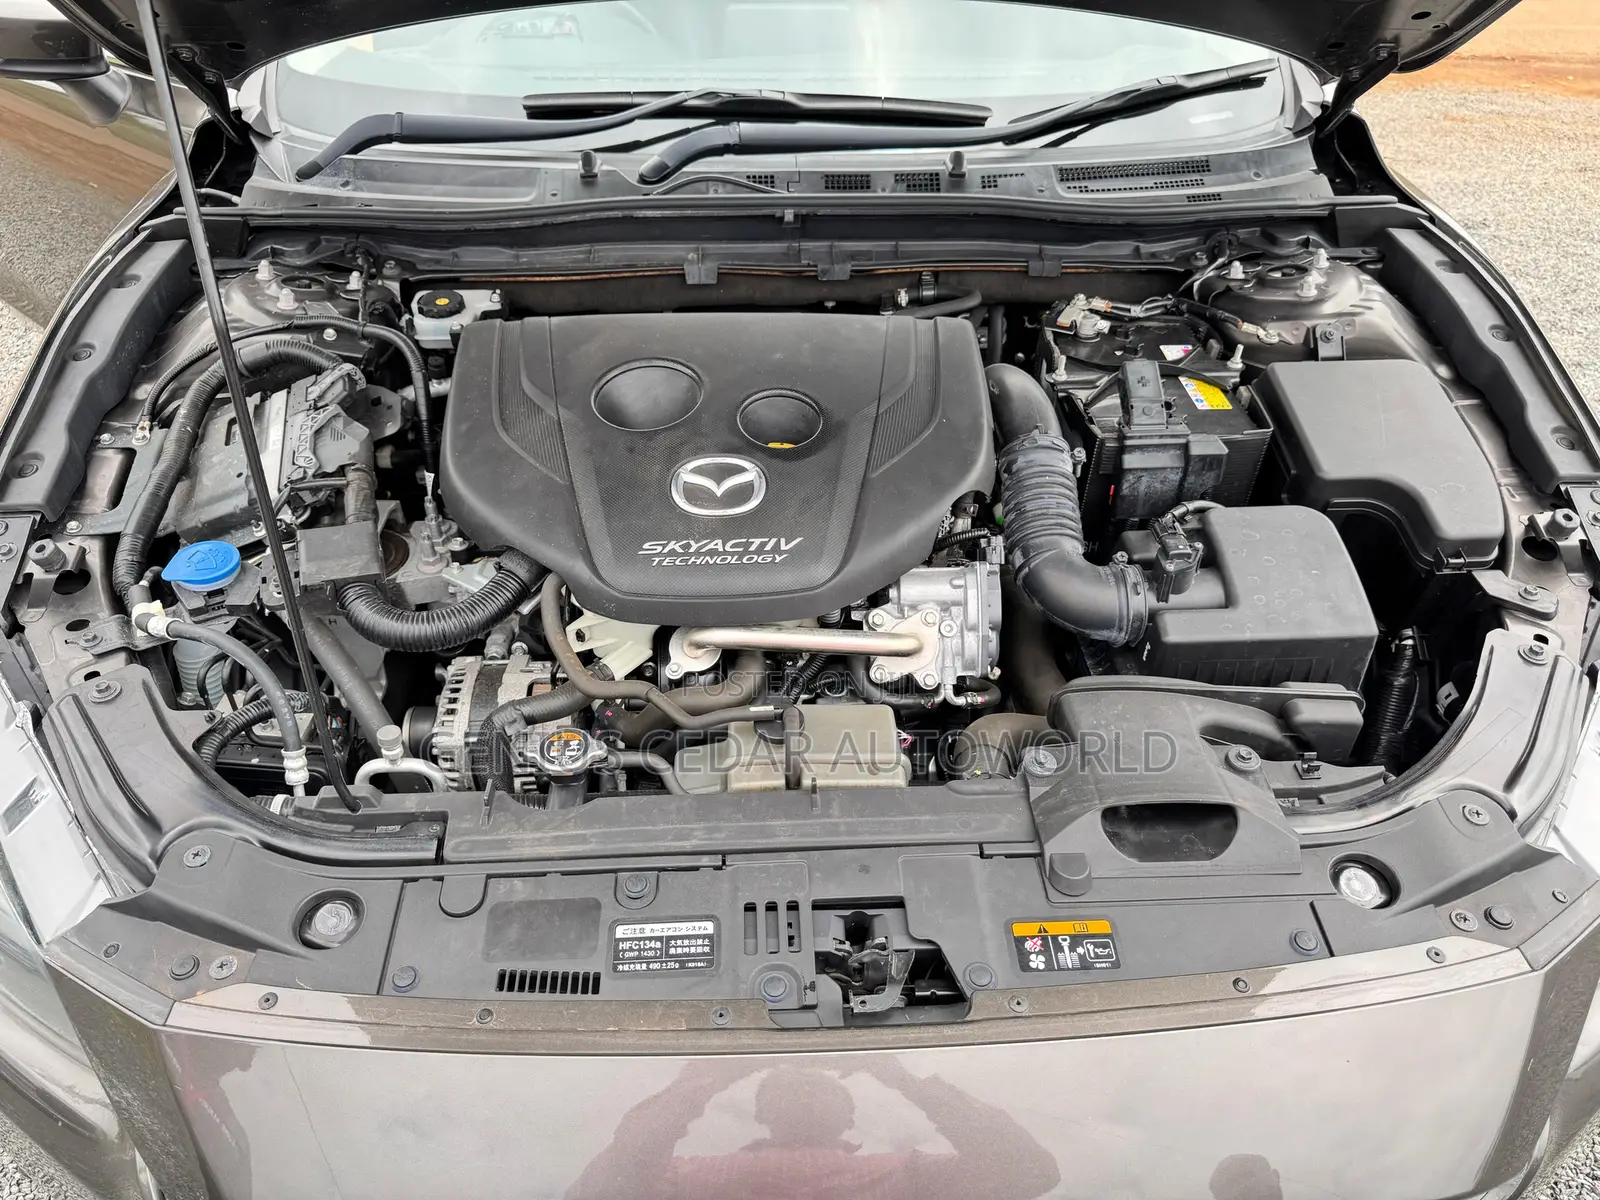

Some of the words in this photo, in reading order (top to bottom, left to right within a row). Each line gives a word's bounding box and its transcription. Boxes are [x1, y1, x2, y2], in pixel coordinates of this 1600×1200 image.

[637, 537, 804, 554] SKYACTIV
[651, 553, 790, 567] TECHNOLOGY
[618, 940, 661, 950] HFC134a
